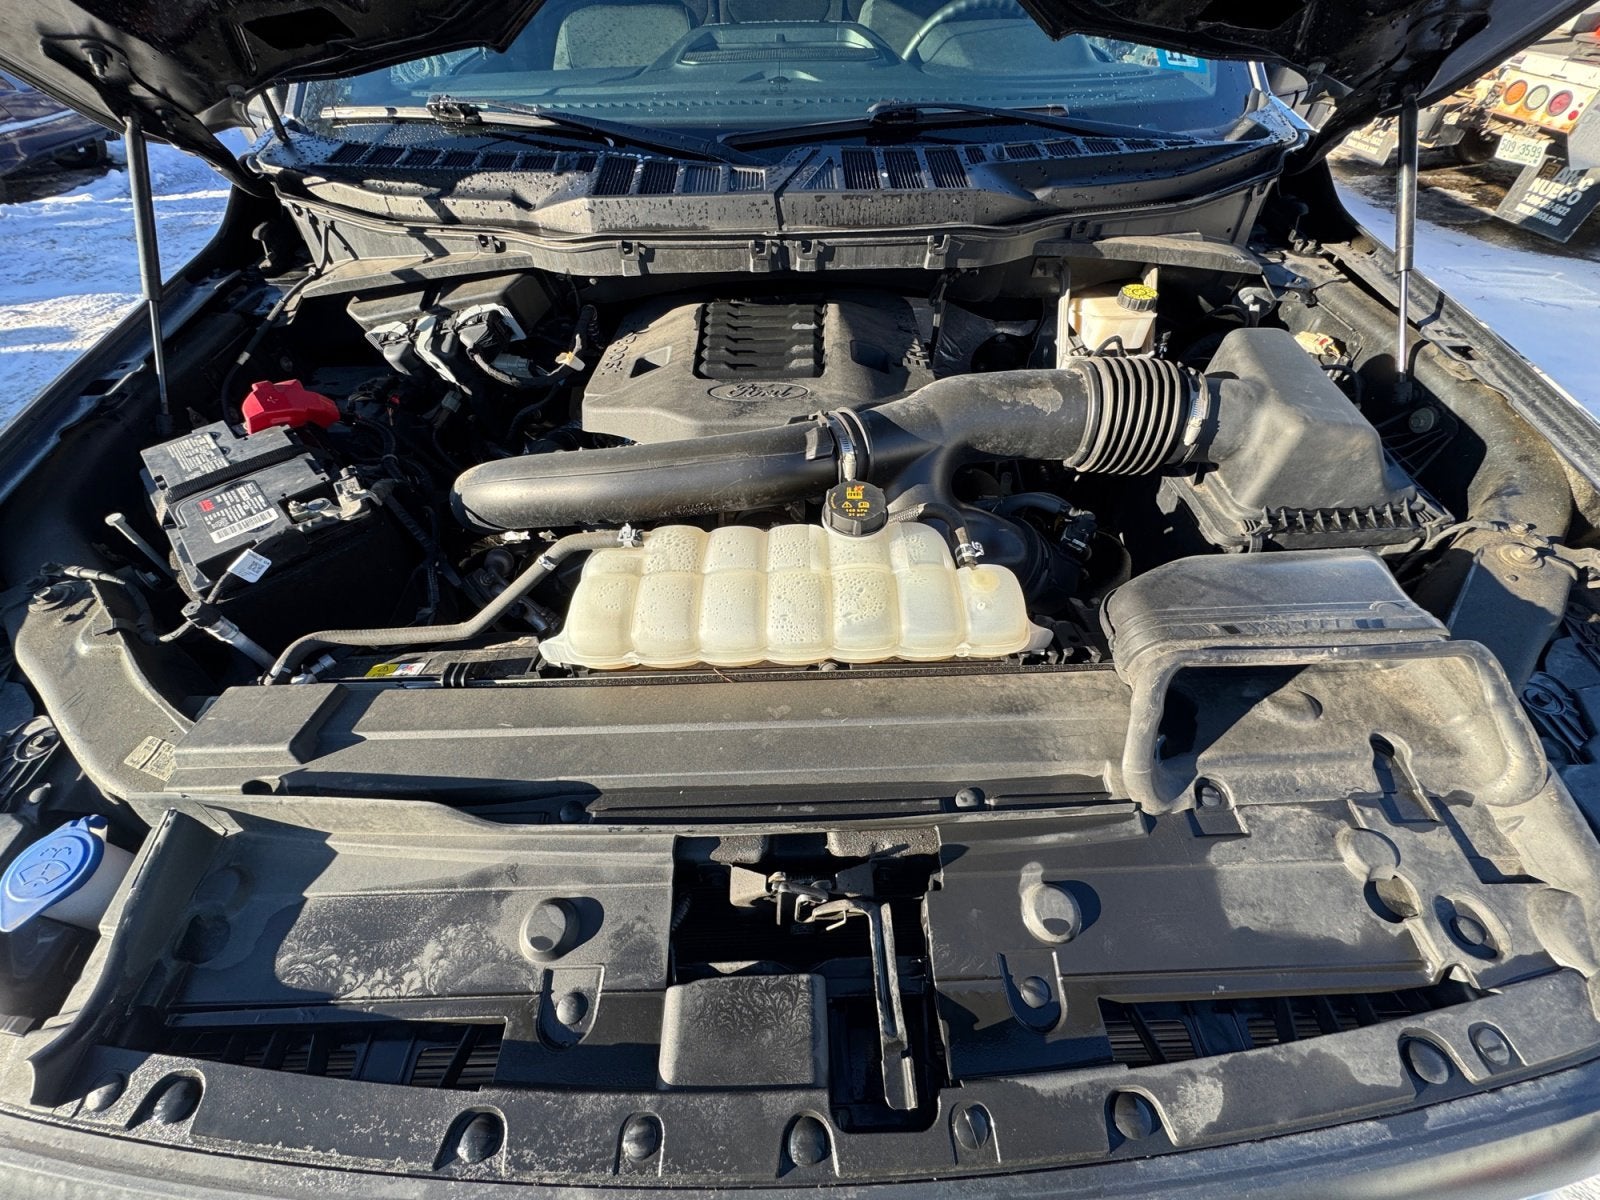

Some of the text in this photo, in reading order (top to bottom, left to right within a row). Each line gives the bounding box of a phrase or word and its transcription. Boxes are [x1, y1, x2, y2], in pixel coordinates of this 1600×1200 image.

[1500, 138, 1516, 153] 509
[1519, 143, 1543, 159] 3599
[1528, 177, 1582, 206] NUECO
[726, 383, 793, 398] Ford
